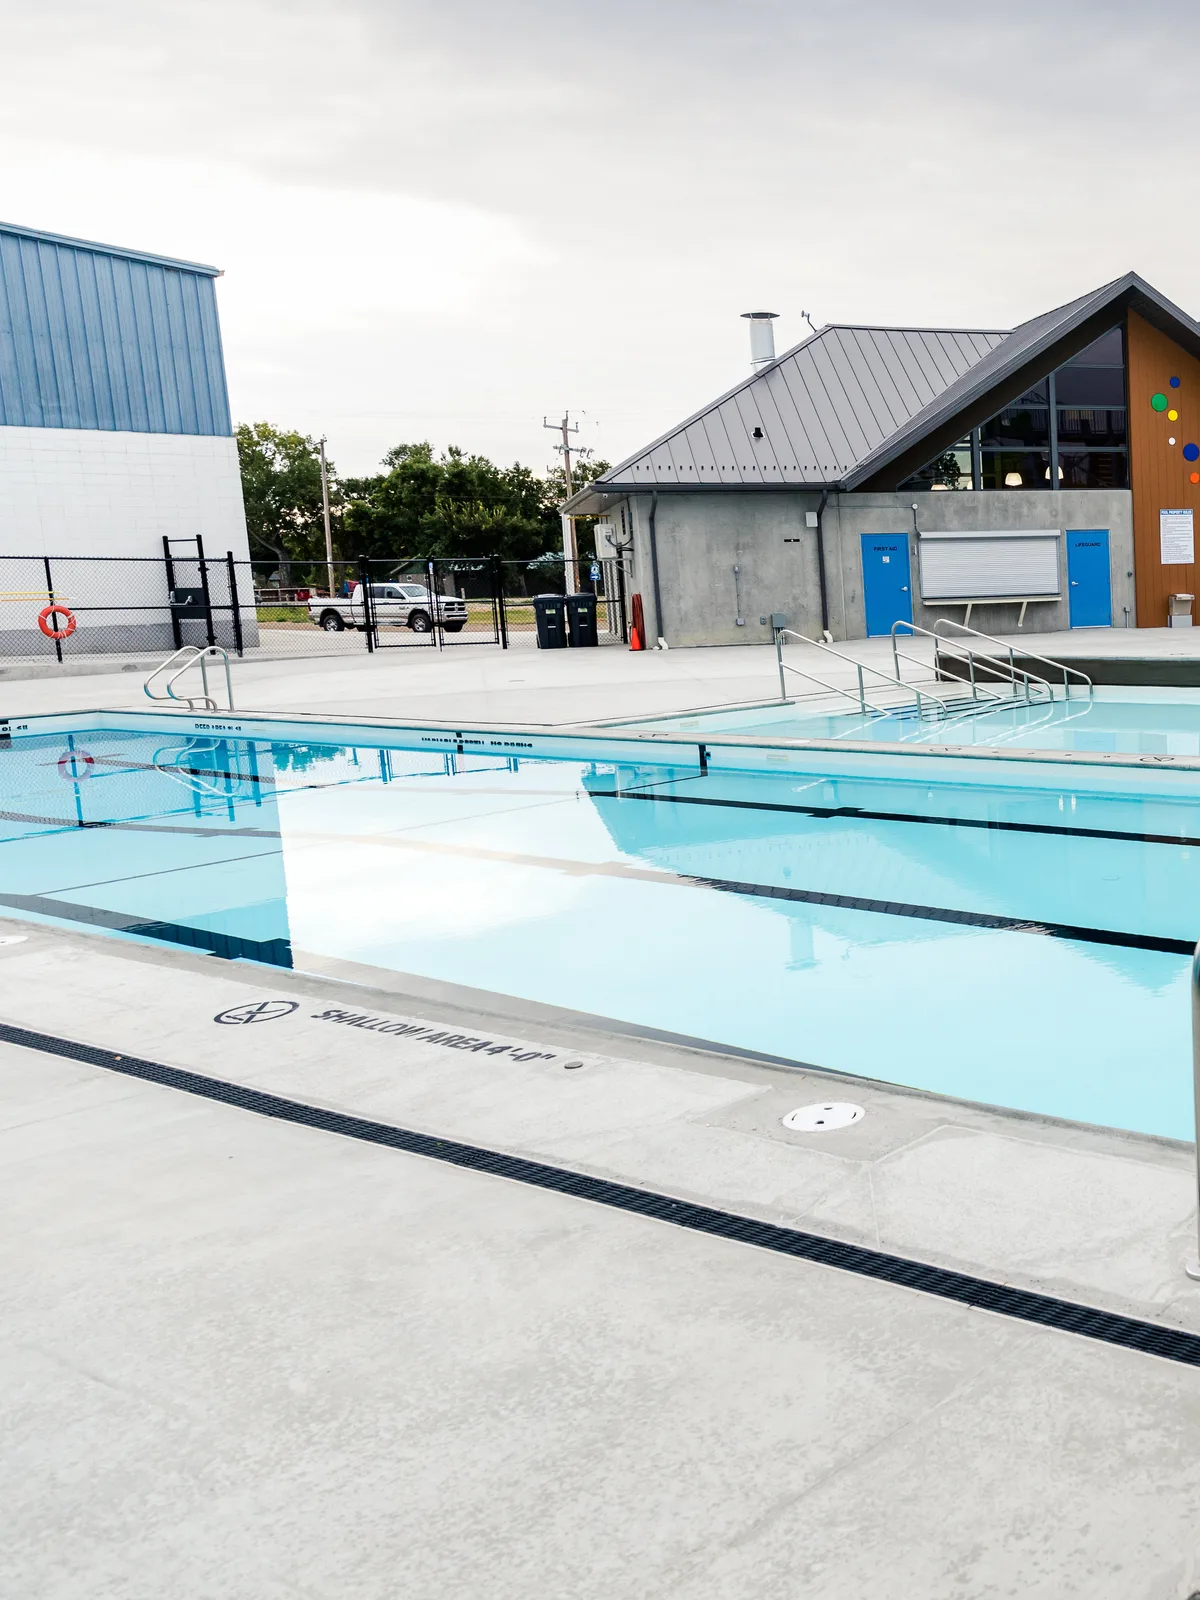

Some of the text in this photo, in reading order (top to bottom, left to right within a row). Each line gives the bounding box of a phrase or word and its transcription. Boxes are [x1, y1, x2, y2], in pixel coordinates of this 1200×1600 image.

[310, 1009, 557, 1062] SHALLOW AREA 4'-0"
